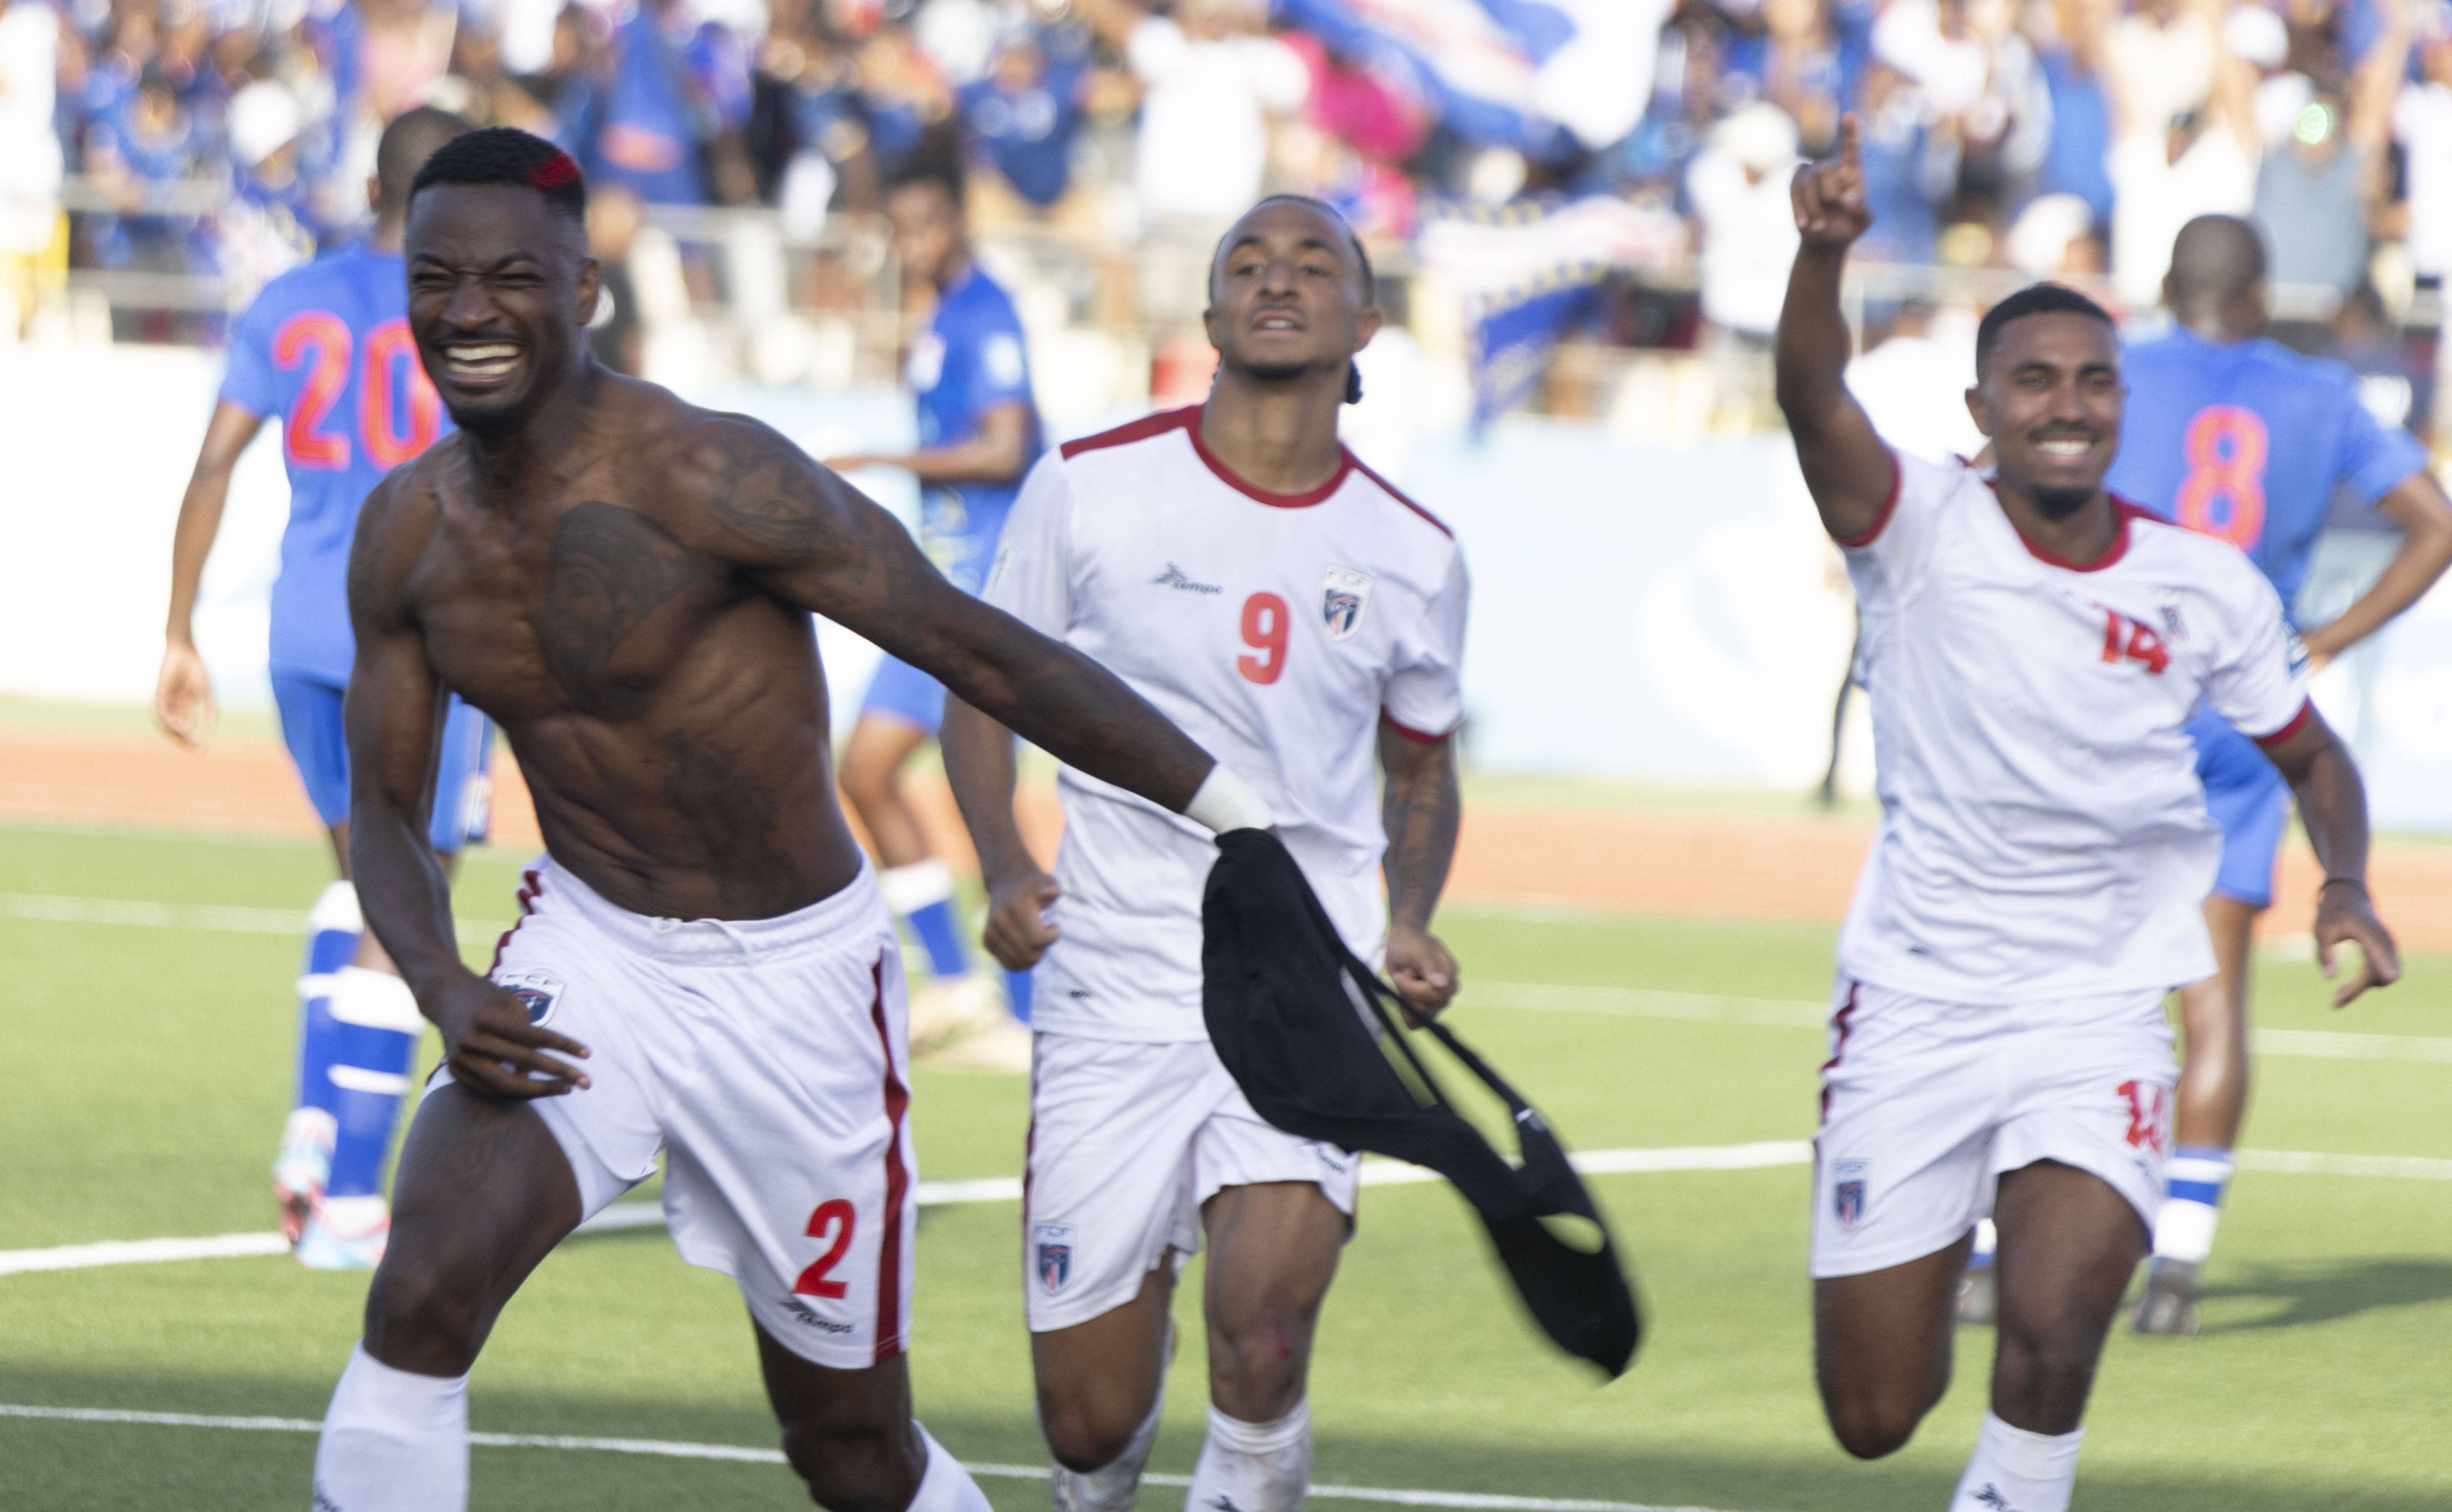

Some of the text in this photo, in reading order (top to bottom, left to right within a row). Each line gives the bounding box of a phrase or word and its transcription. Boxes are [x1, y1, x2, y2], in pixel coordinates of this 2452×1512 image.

[272, 309, 442, 471] 20
[2175, 404, 2268, 554] 8
[1238, 591, 1290, 685] 9
[2092, 600, 2171, 674] 14
[791, 1199, 856, 1299] 2
